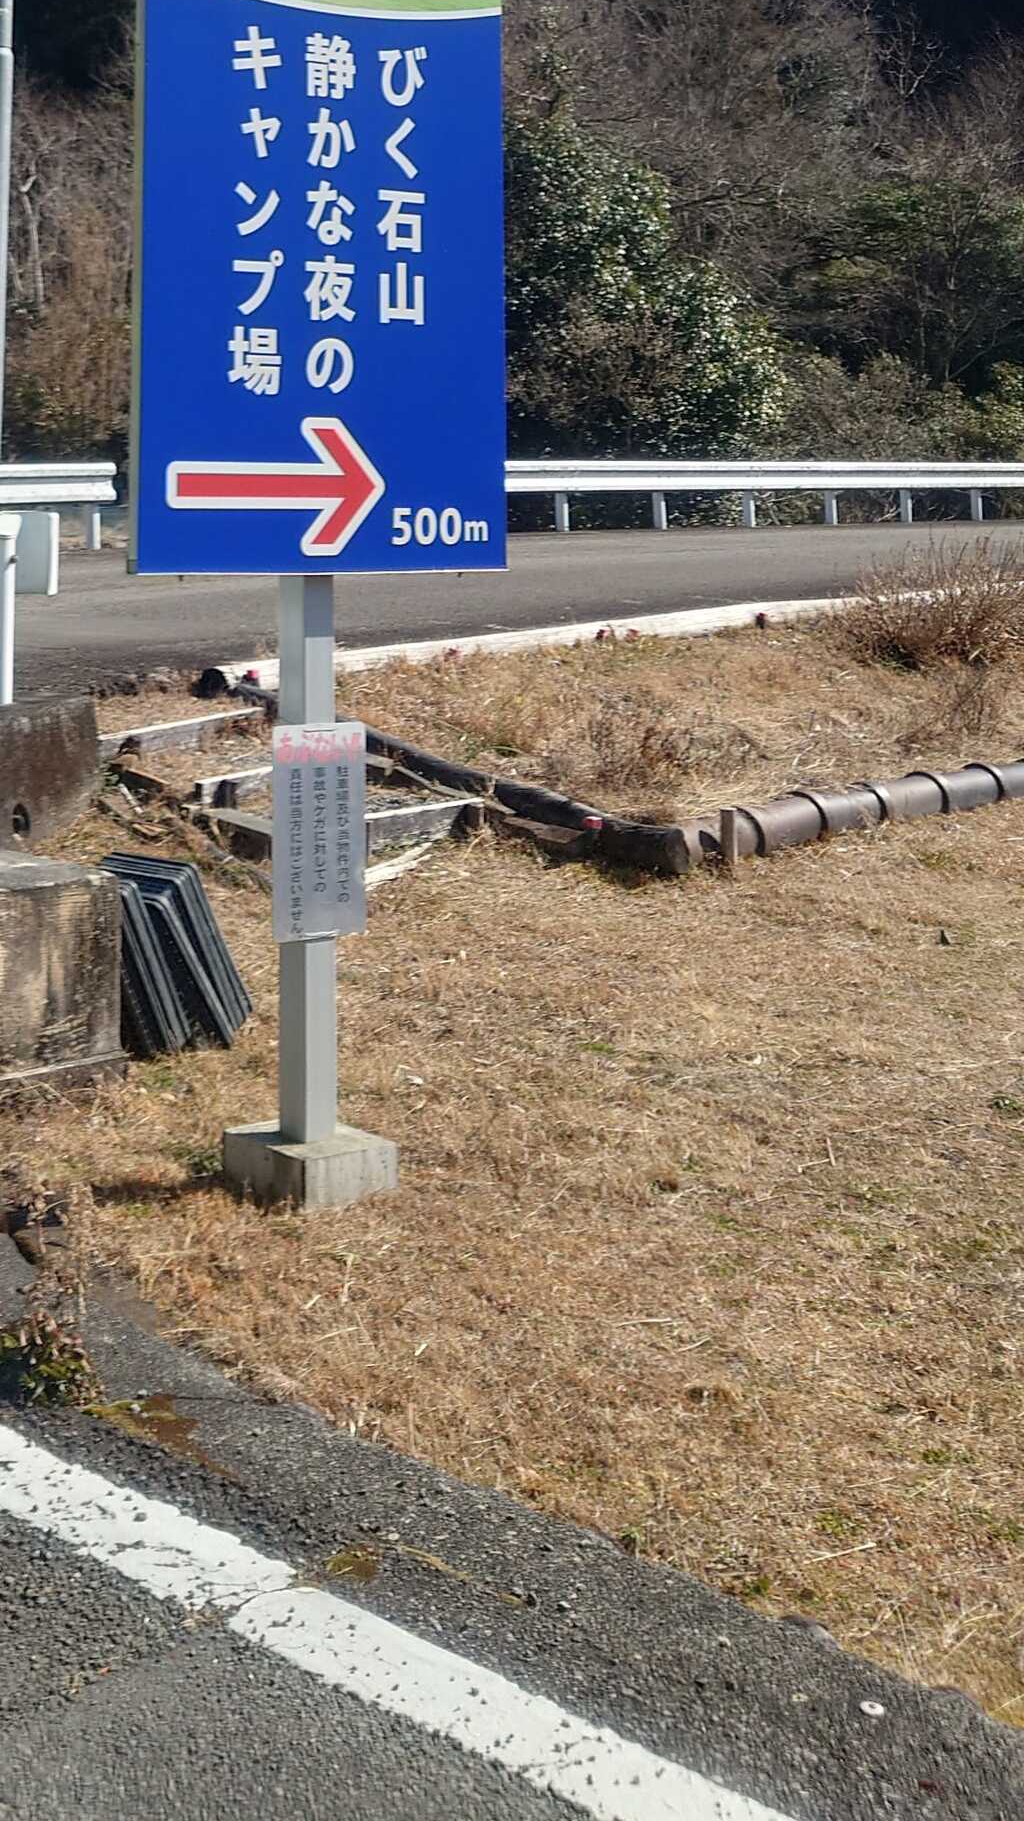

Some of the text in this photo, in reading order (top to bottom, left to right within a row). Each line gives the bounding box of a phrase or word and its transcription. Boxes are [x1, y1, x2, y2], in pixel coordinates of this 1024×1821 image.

[227, 26, 284, 395] キャンプ場
[304, 32, 357, 394] 静かな夜の
[377, 47, 427, 325] びく石山
[392, 507, 489, 546] 500m
